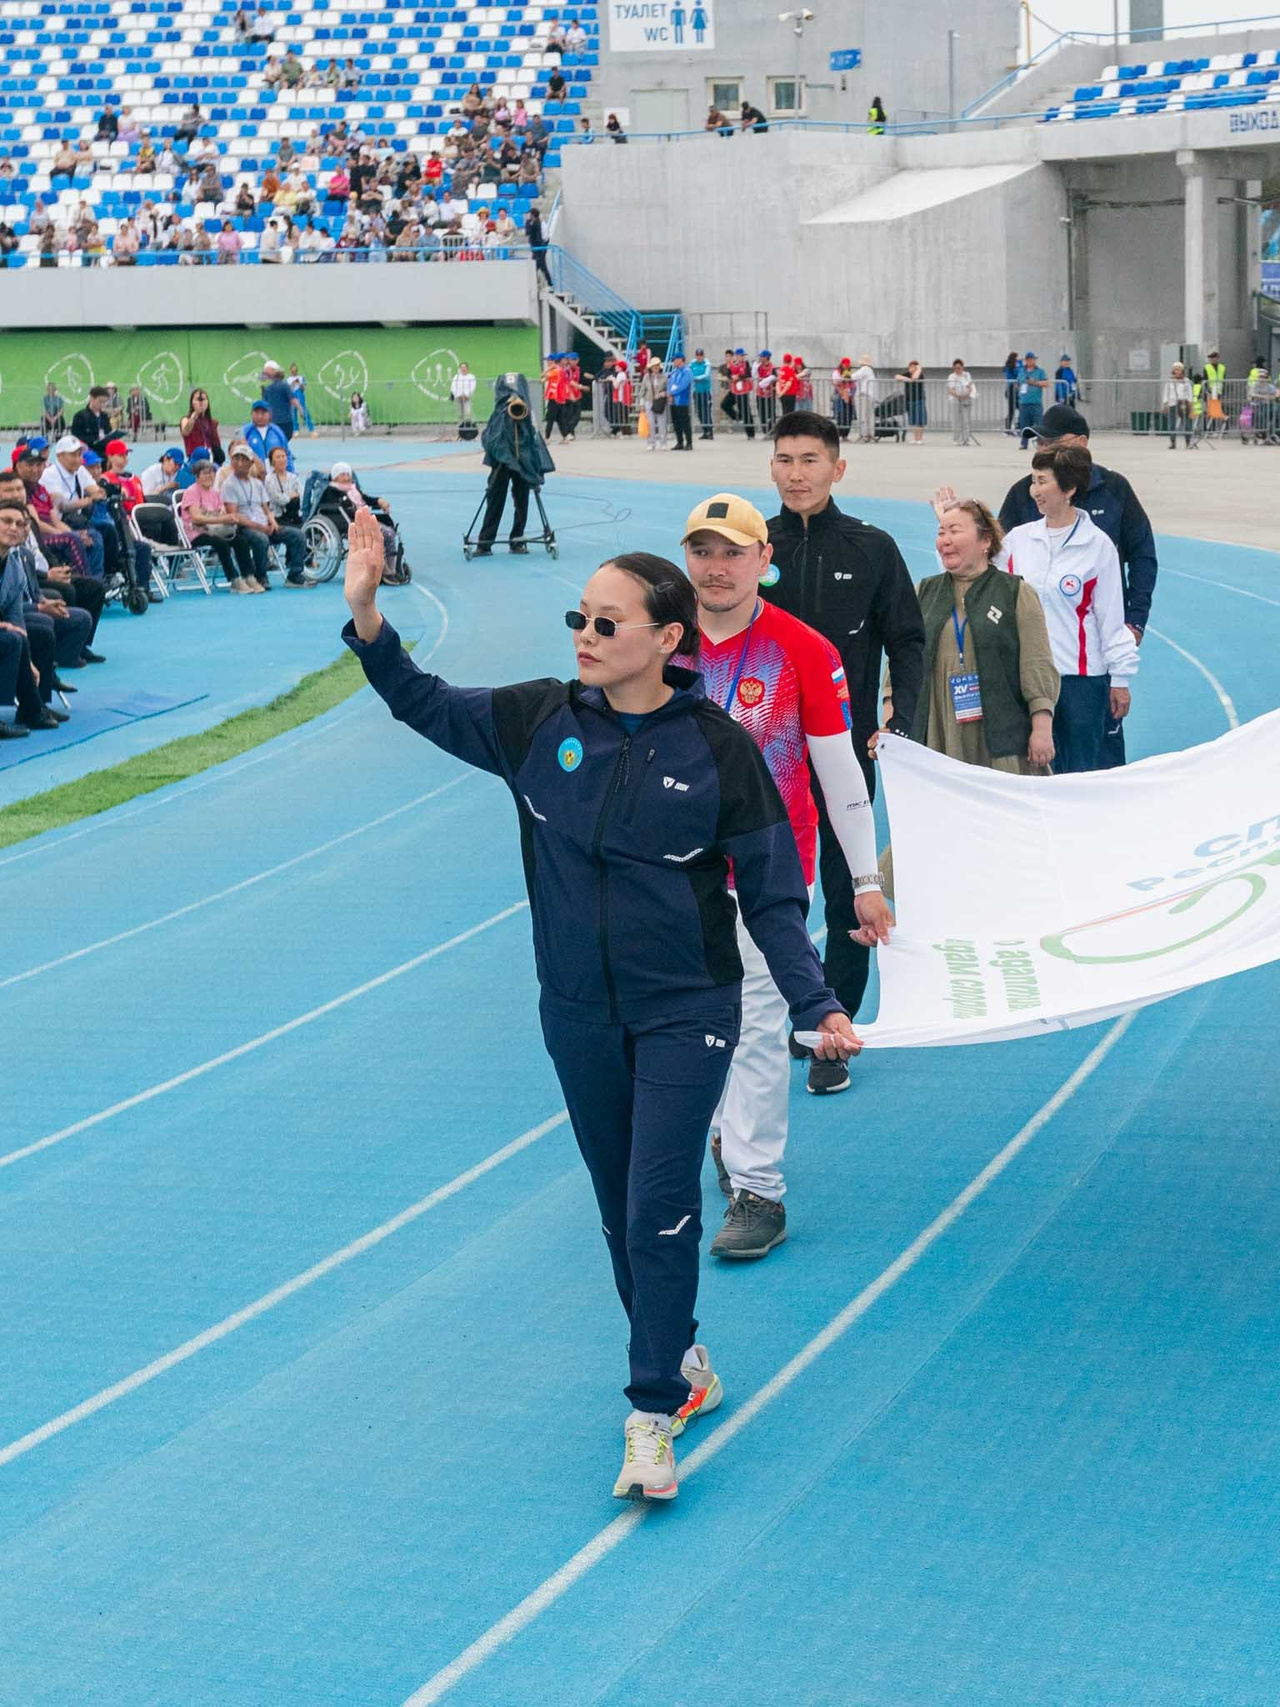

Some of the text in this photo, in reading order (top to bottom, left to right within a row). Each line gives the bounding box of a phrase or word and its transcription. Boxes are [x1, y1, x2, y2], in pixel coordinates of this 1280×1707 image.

[614, 3, 667, 20] ТУАЛЕТ
[644, 26, 669, 42] WC
[1229, 110, 1280, 133] ВЫХОД
